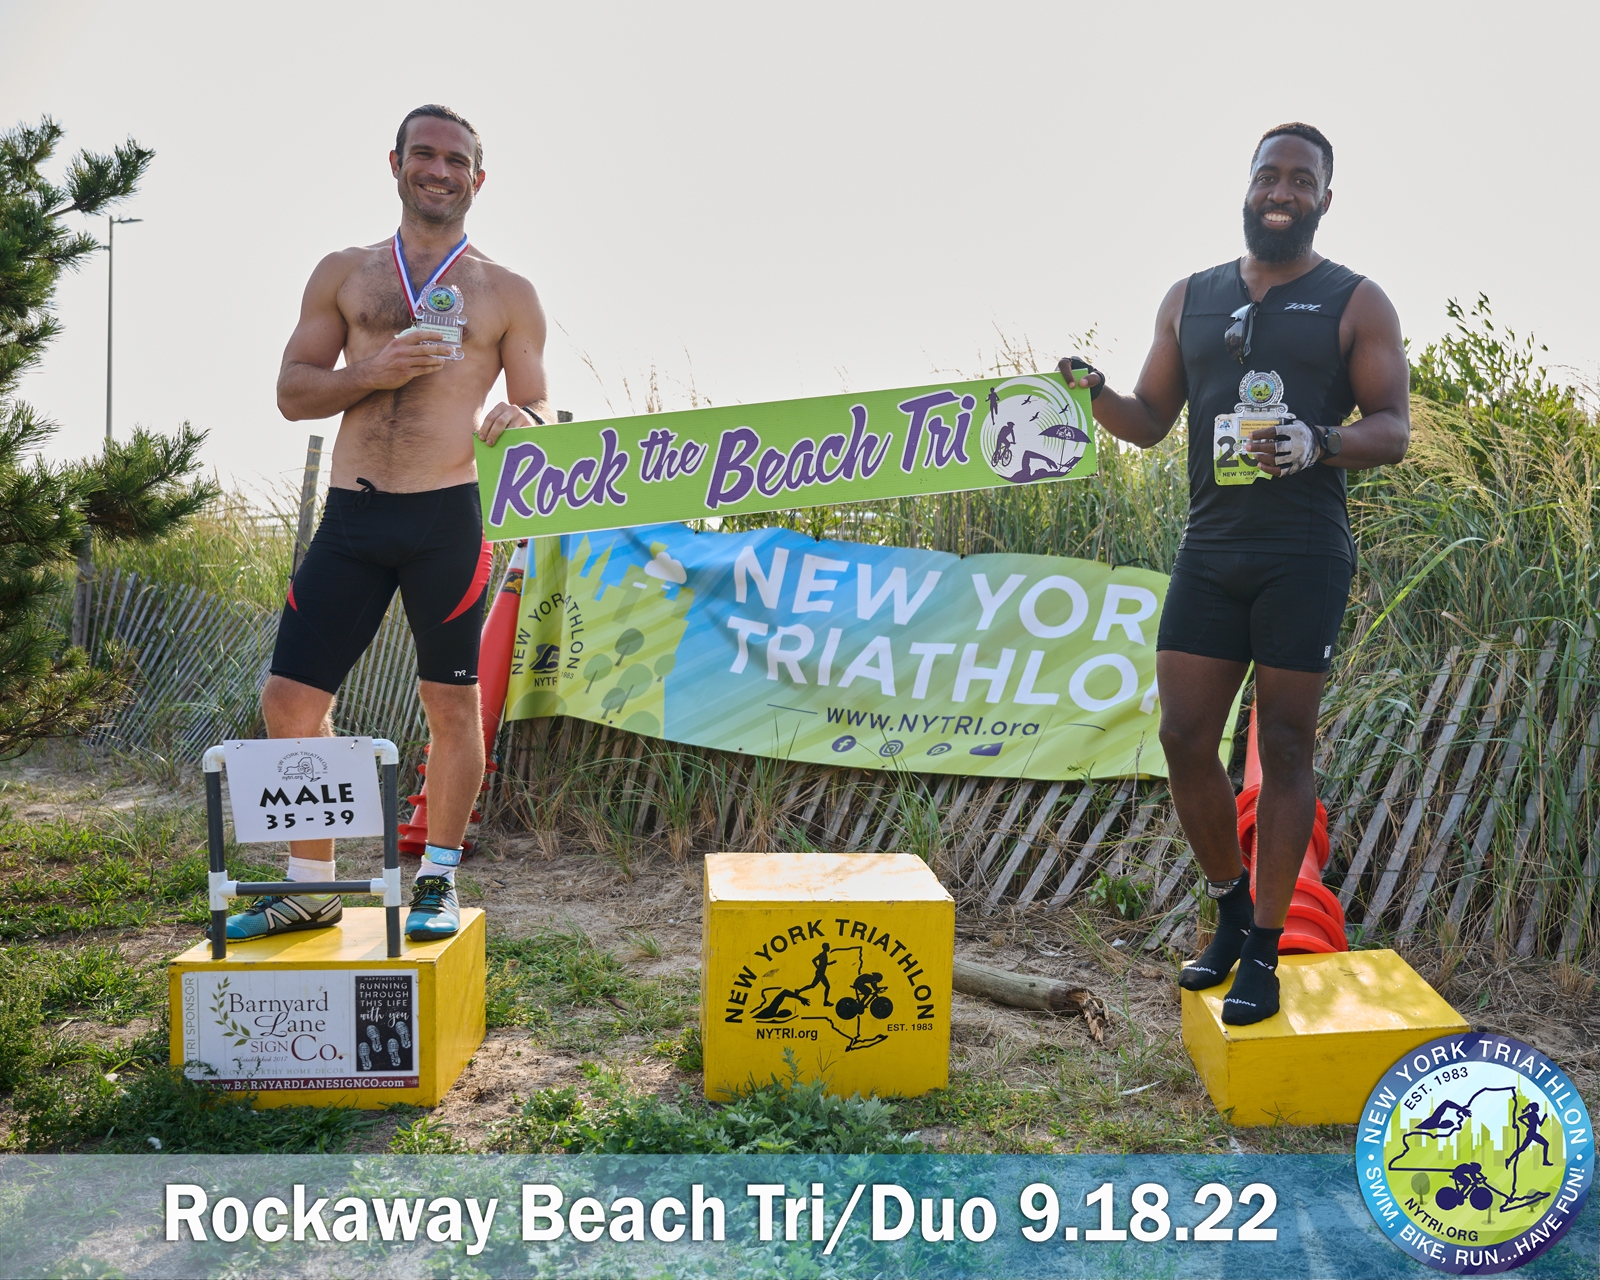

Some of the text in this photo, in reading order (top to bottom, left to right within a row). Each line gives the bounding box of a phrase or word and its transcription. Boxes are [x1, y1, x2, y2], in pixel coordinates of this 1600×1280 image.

[489, 390, 975, 527] Rock the Beach Tri
[733, 545, 1158, 646] NEW YOR
[511, 592, 585, 675] NEW YOR ATHLON
[453, 669, 467, 677] TYR
[726, 615, 1158, 715] TRIATHLO
[277, 751, 328, 773] NEW YORK TRIATHLON
[259, 782, 355, 808] MALE
[725, 918, 935, 1024] NEW YORK TRIATHLON
[359, 982, 408, 990] RUNNING
[359, 990, 409, 998] THROUGH
[184, 977, 195, 1036] SPONSOR
[228, 991, 329, 1014] Barnyard
[361, 999, 408, 1007] THIS LIFE
[254, 1011, 326, 1038] Lane
[360, 1006, 409, 1028] with you
[887, 1022, 933, 1032] EST. 1983
[756, 1027, 818, 1041] NYTRI.org
[251, 1033, 344, 1062] SIGN Co.
